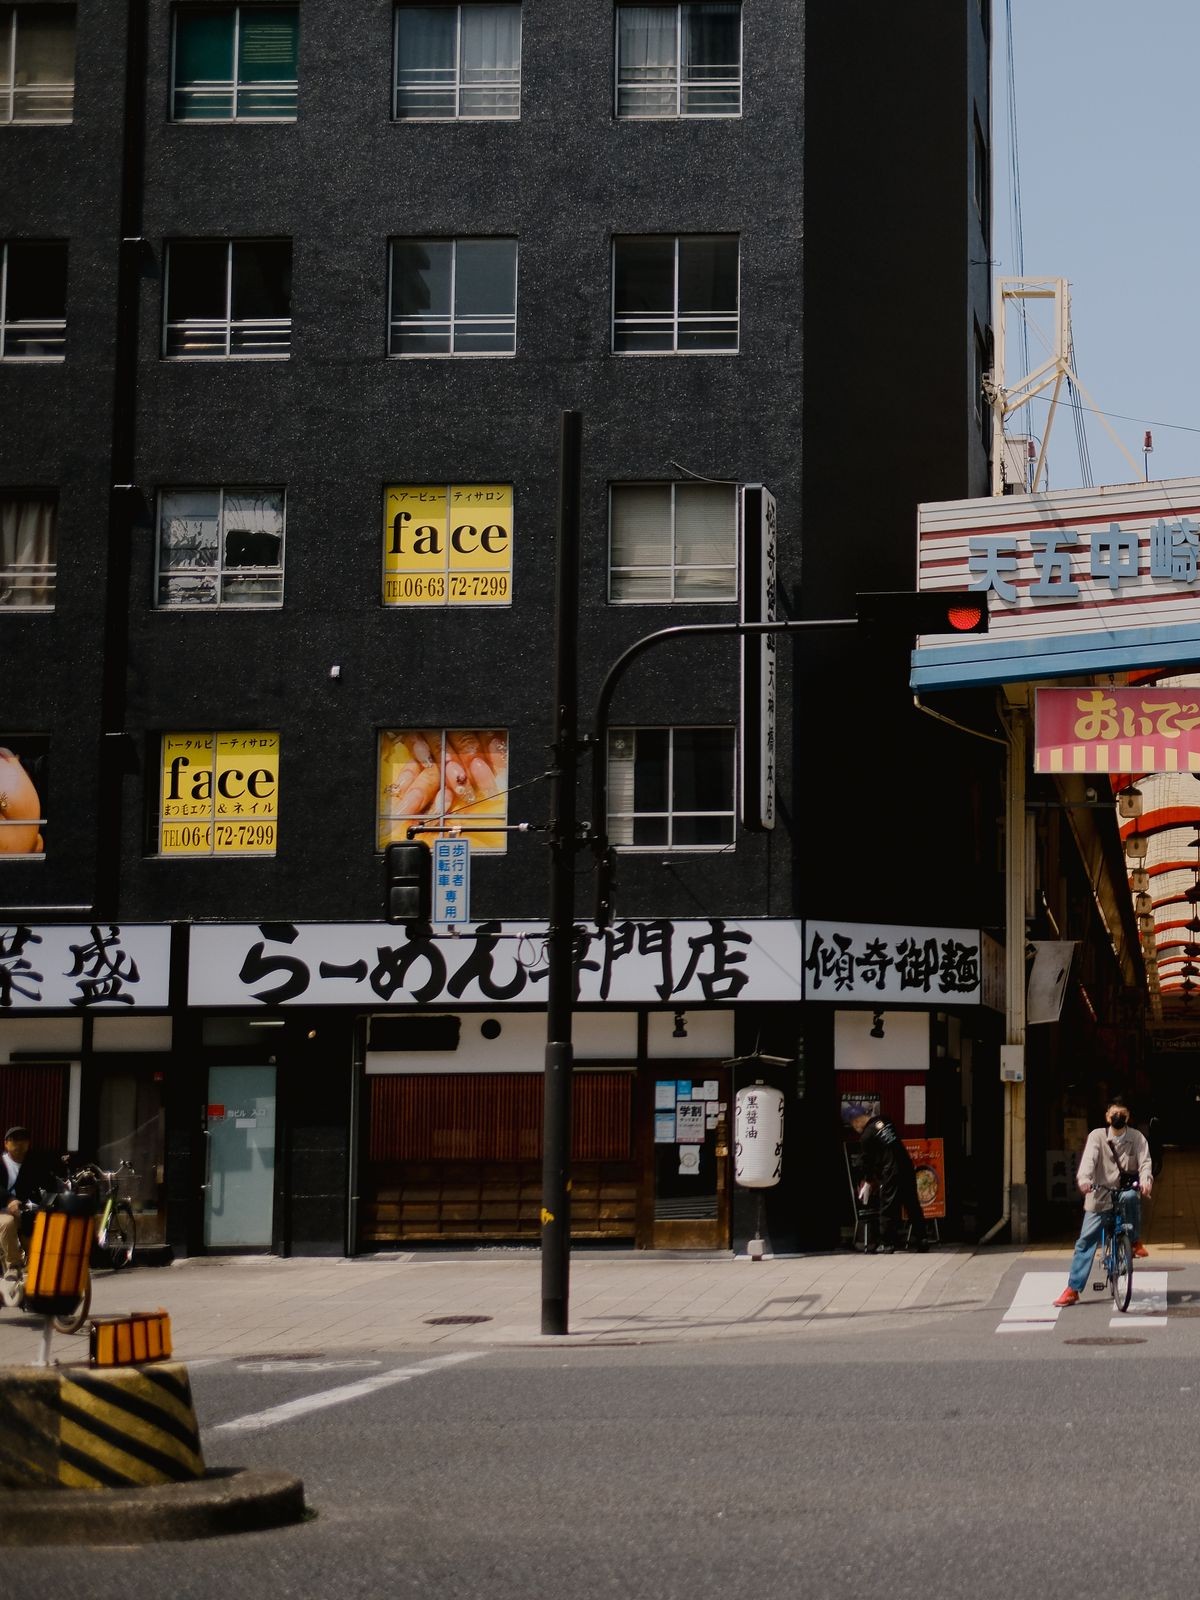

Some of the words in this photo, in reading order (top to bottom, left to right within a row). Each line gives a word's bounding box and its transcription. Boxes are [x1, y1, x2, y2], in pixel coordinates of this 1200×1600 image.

[389, 491, 505, 502] ヘアービューティサロン
[388, 511, 509, 555] face
[165, 756, 276, 800] face
[438, 845, 450, 887] 自転車
[452, 844, 465, 887] 歩行者
[445, 890, 457, 918] 専用
[680, 1105, 702, 1117] 学割
[745, 1095, 759, 1140] 黒醤油
